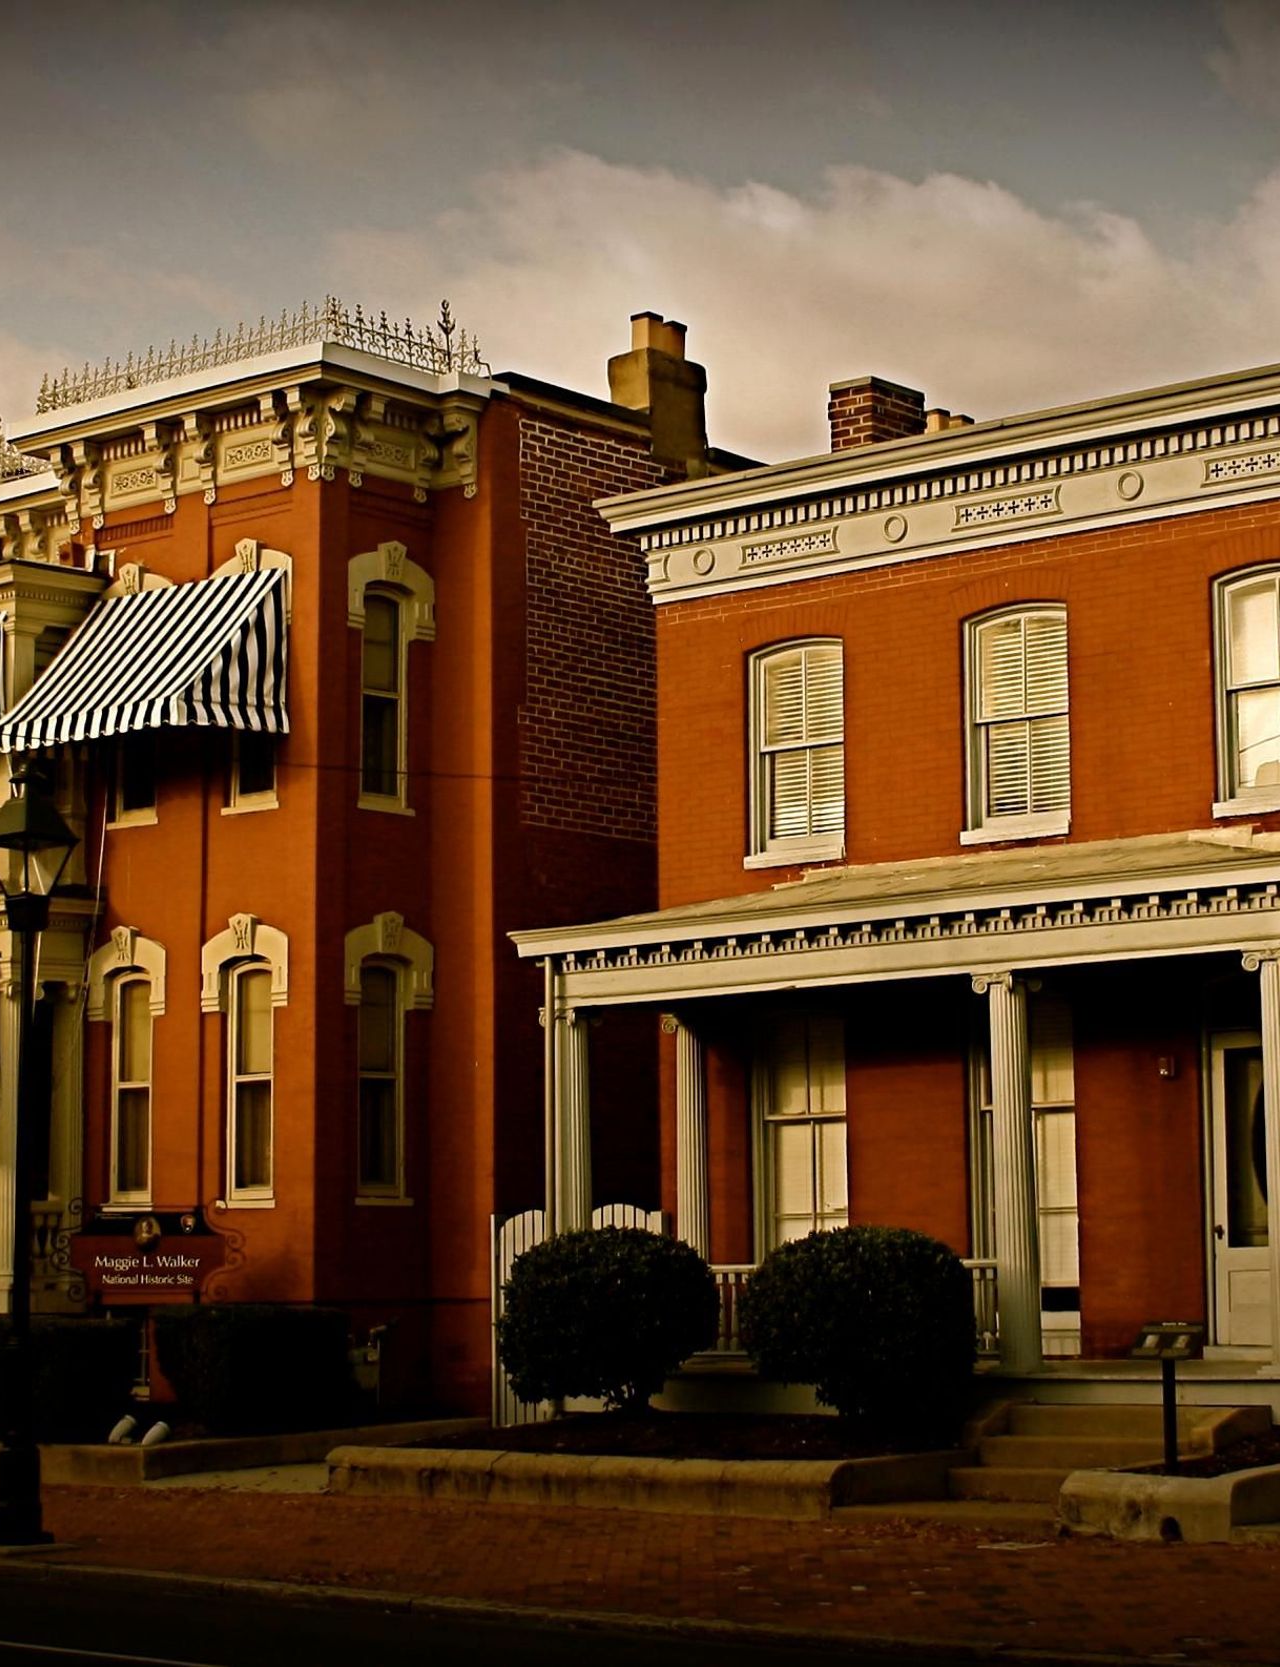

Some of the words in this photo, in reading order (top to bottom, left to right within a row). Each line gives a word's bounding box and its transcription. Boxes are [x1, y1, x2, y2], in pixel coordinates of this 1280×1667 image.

[94, 1255, 140, 1271] Maggie
[143, 1255, 154, 1268] L.
[156, 1254, 201, 1268] Walker
[102, 1273, 139, 1284] National
[140, 1273, 175, 1284] Historic
[177, 1273, 194, 1284] Site
